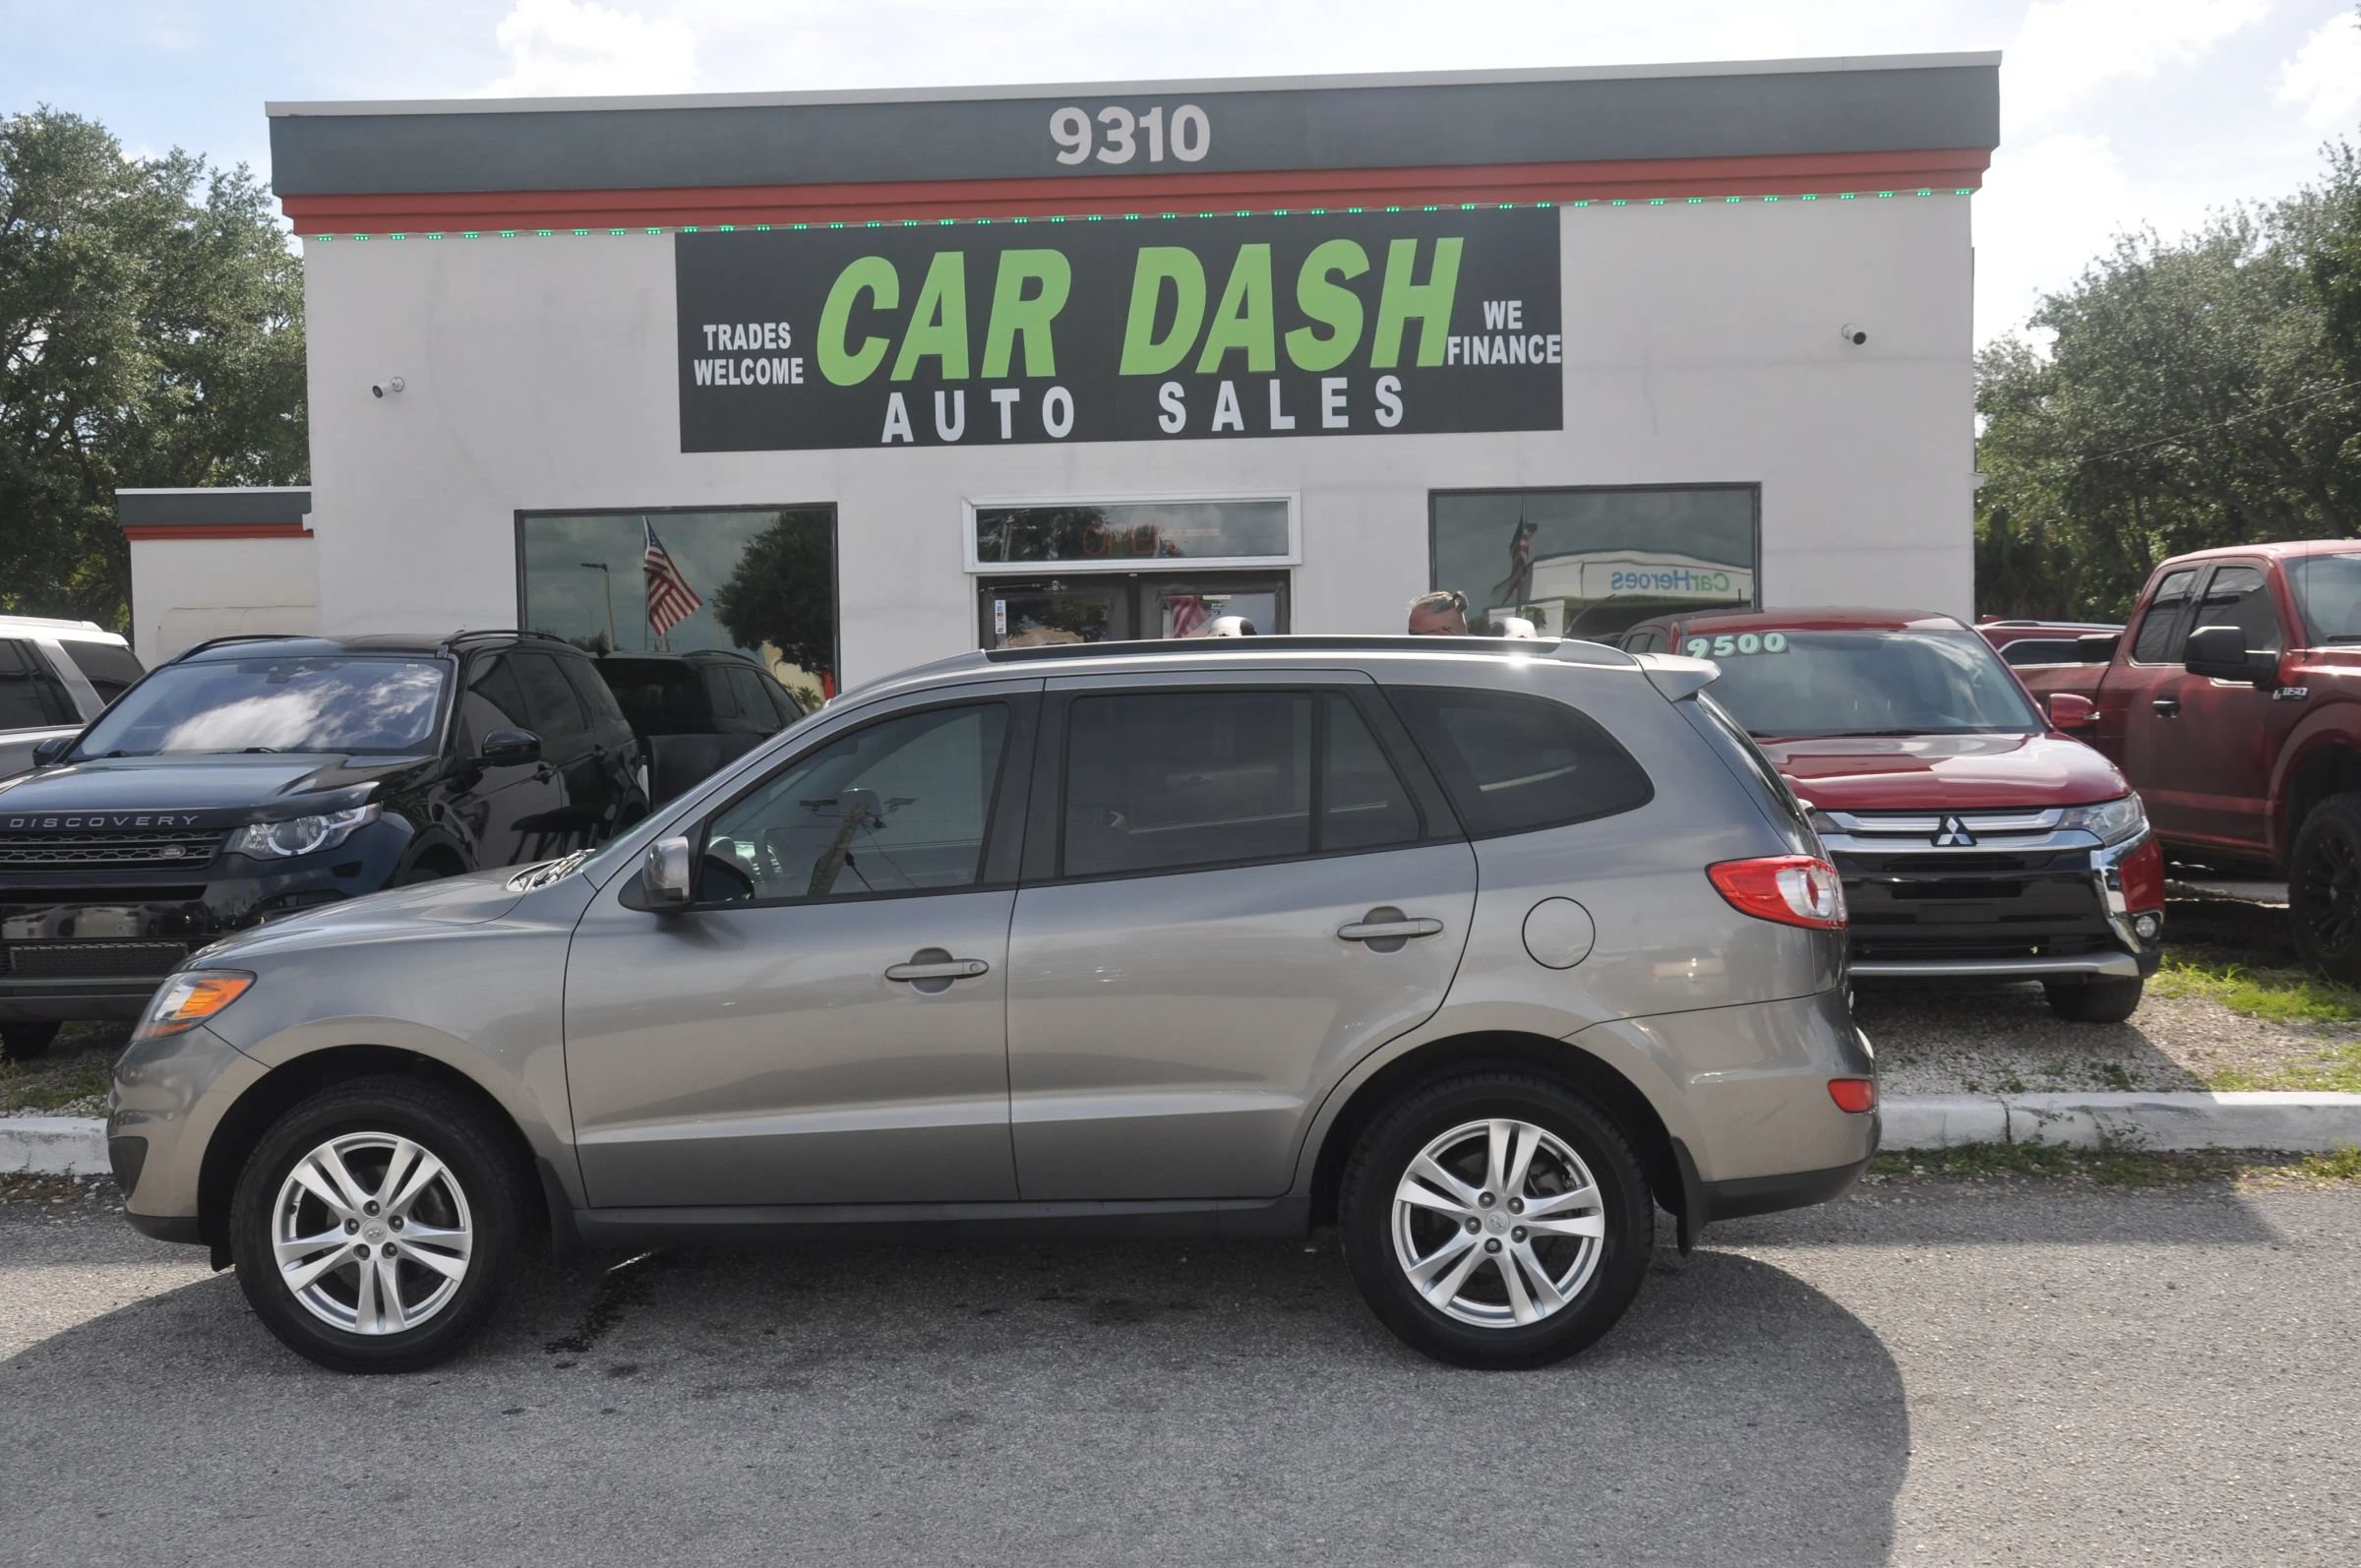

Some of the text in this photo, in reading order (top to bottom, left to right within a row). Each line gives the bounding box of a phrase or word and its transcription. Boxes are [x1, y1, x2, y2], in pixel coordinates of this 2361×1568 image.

[1049, 104, 1211, 165] 9310
[817, 237, 1464, 387] CAR DASH
[1483, 300, 1523, 330] WE
[702, 322, 792, 351] TRADES
[1447, 333, 1562, 366] FINANCE
[694, 357, 804, 387] WELCOME
[879, 374, 1406, 445] AUTO SALES
[1686, 632, 1788, 659] 9500
[9, 815, 199, 828] DISCOVERY
